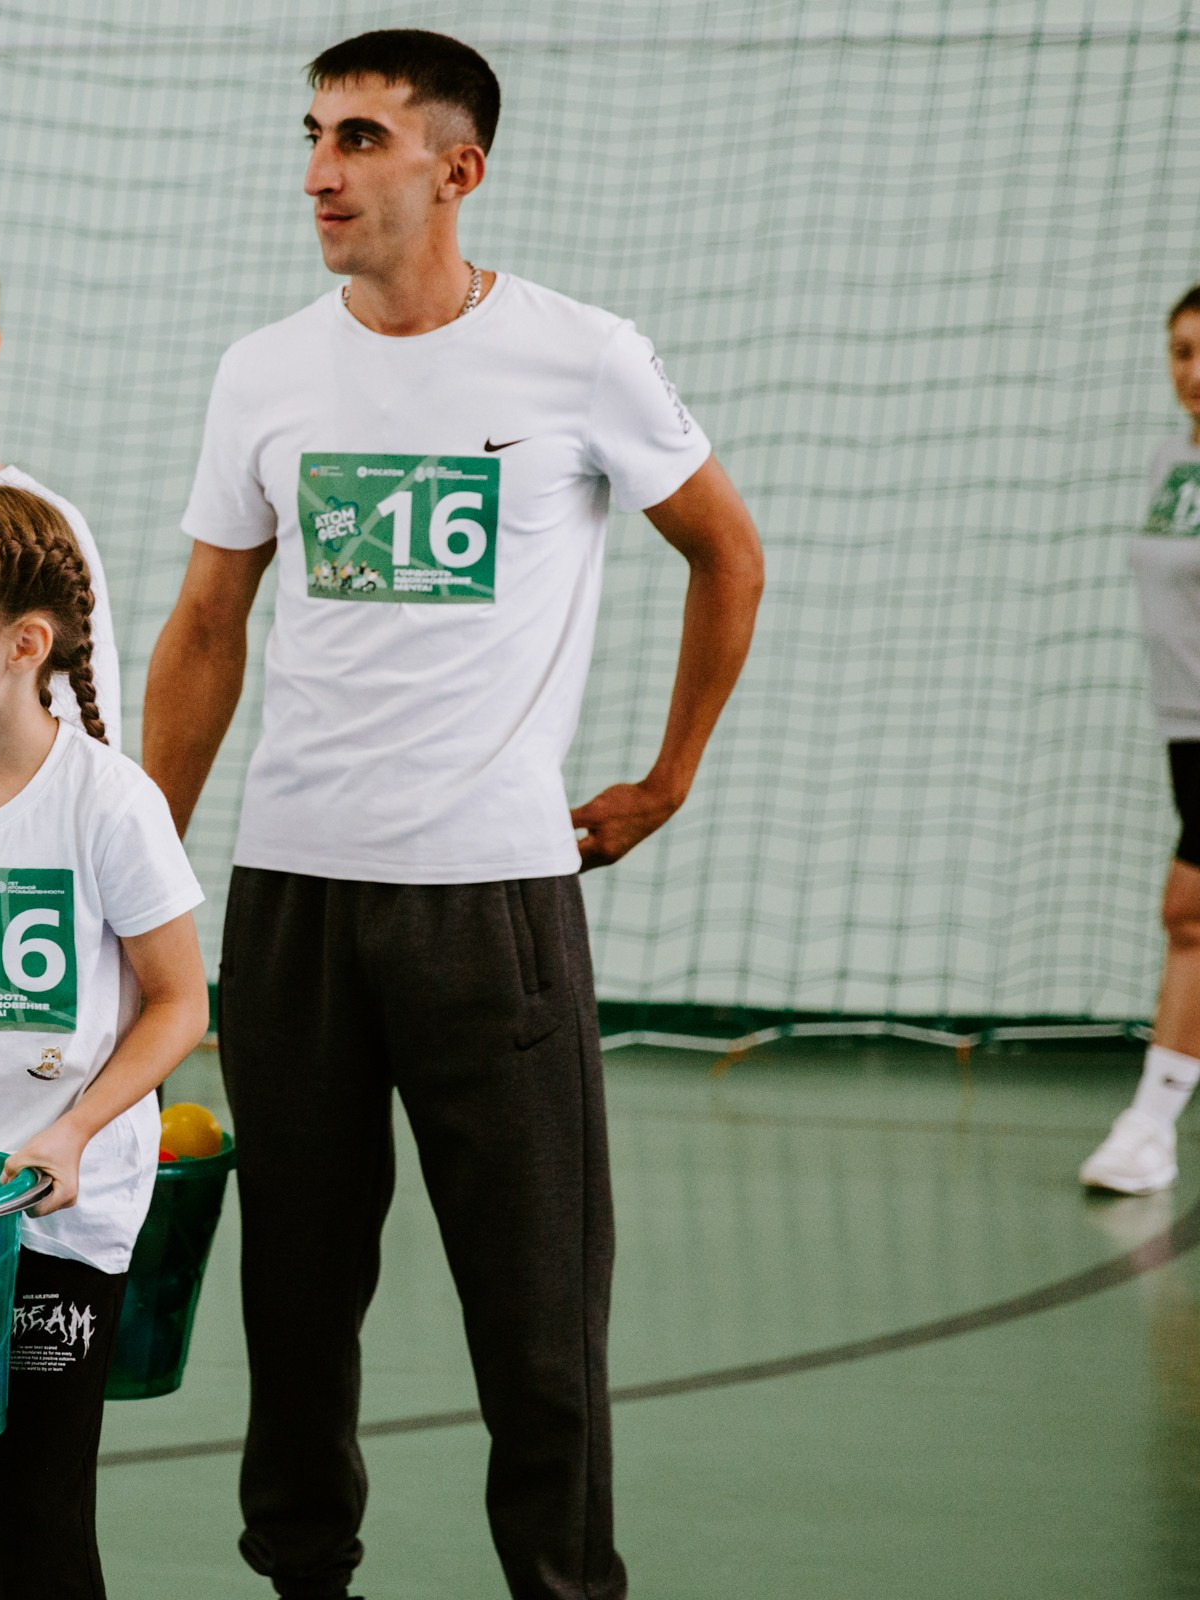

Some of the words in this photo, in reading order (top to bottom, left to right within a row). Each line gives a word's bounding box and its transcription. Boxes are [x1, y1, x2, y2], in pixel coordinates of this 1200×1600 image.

[315, 507, 356, 530] АТОМ
[377, 490, 487, 568] 16
[11, 1300, 97, 1359] REAM
